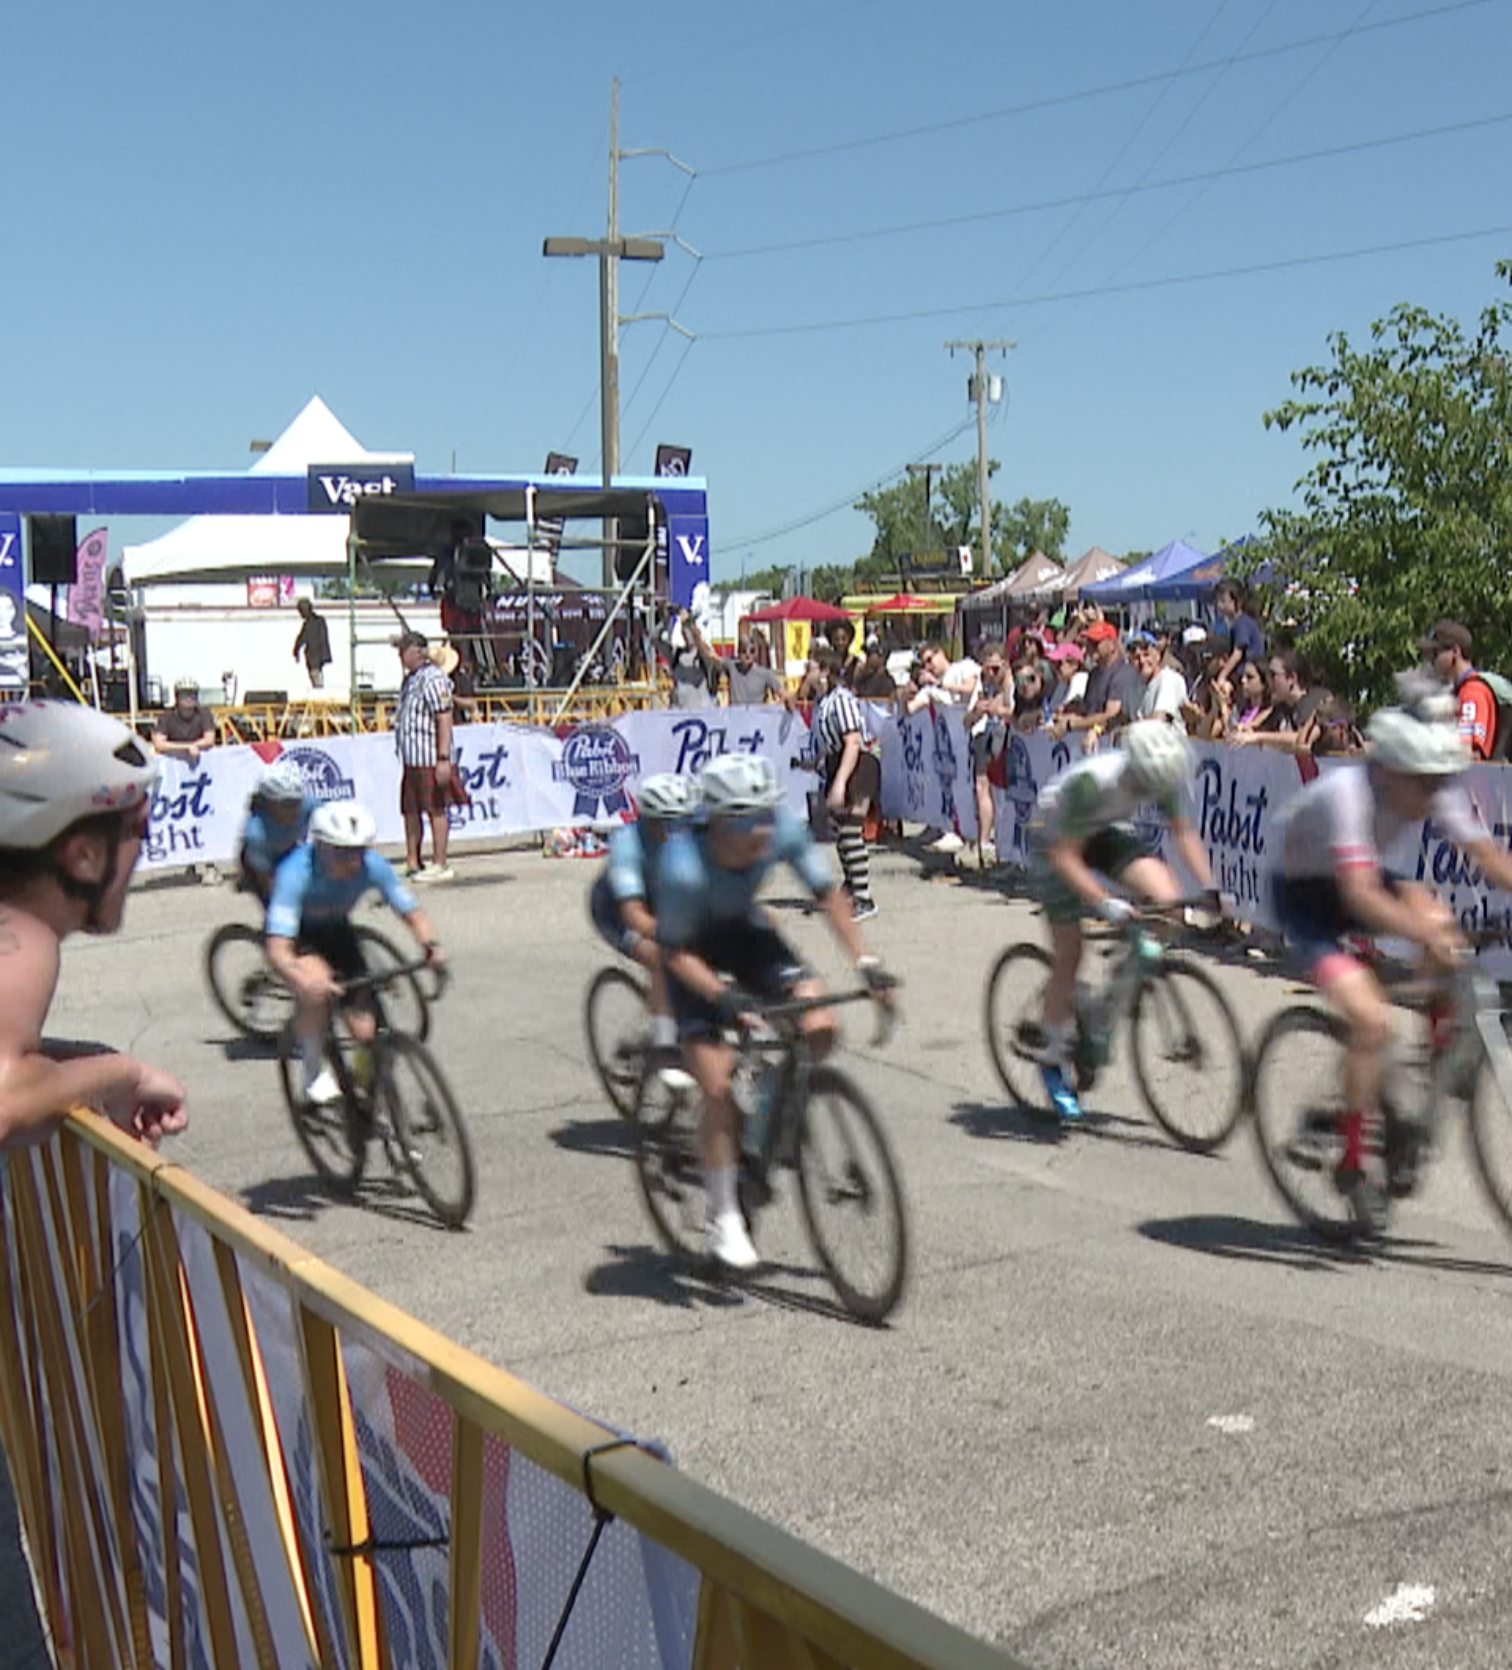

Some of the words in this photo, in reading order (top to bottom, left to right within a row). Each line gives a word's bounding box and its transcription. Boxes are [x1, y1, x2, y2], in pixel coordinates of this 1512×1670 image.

[150, 772, 212, 821] bst
[447, 795, 501, 830] ght
[1197, 758, 1268, 855] Pabst
[146, 823, 205, 861] ght
